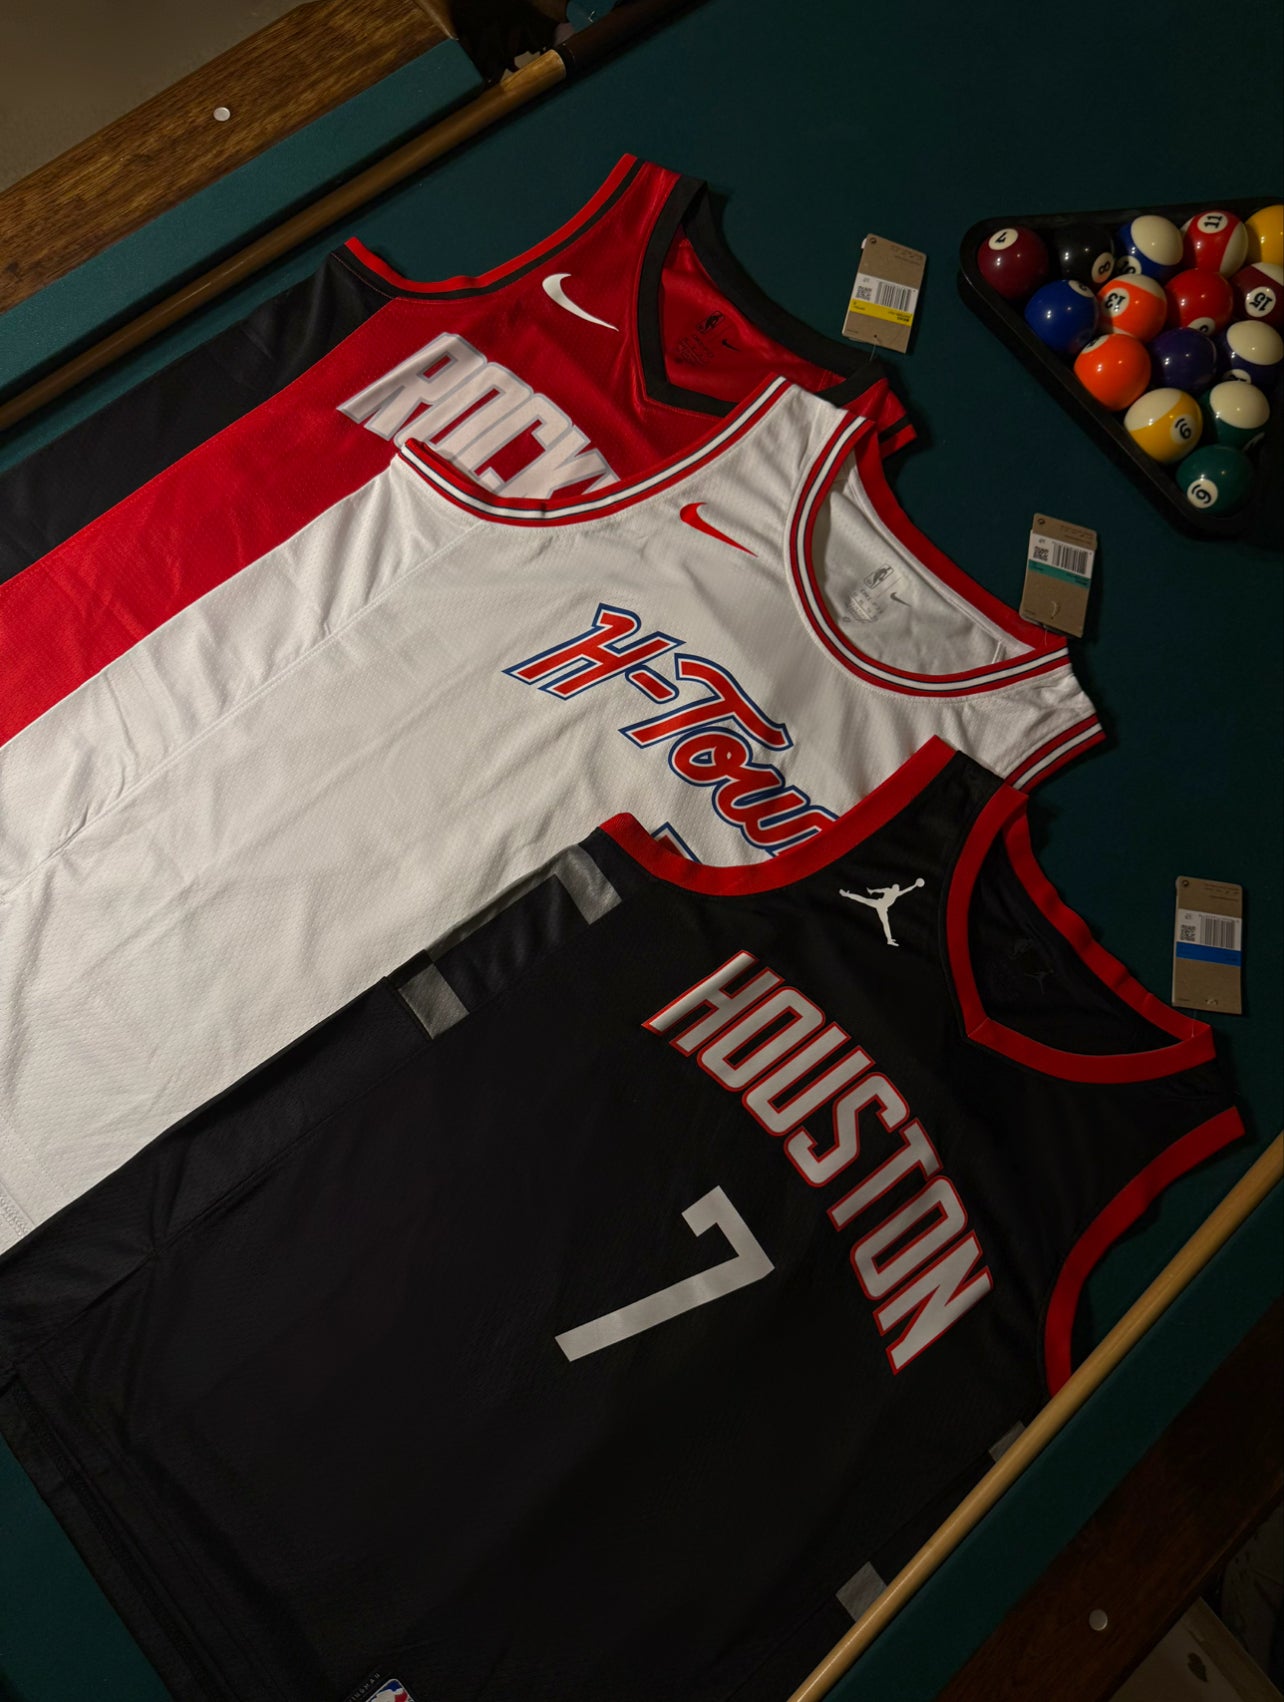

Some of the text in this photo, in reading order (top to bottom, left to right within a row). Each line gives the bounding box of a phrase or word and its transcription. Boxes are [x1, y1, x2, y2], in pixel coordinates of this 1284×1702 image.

[1204, 215, 1222, 229] 11
[1098, 261, 1111, 275] 8
[1105, 292, 1126, 310] 13
[1249, 292, 1273, 311] 15
[336, 331, 620, 500] ROCK
[641, 949, 993, 1375] HOUSTON
[554, 1185, 776, 1362] 7
